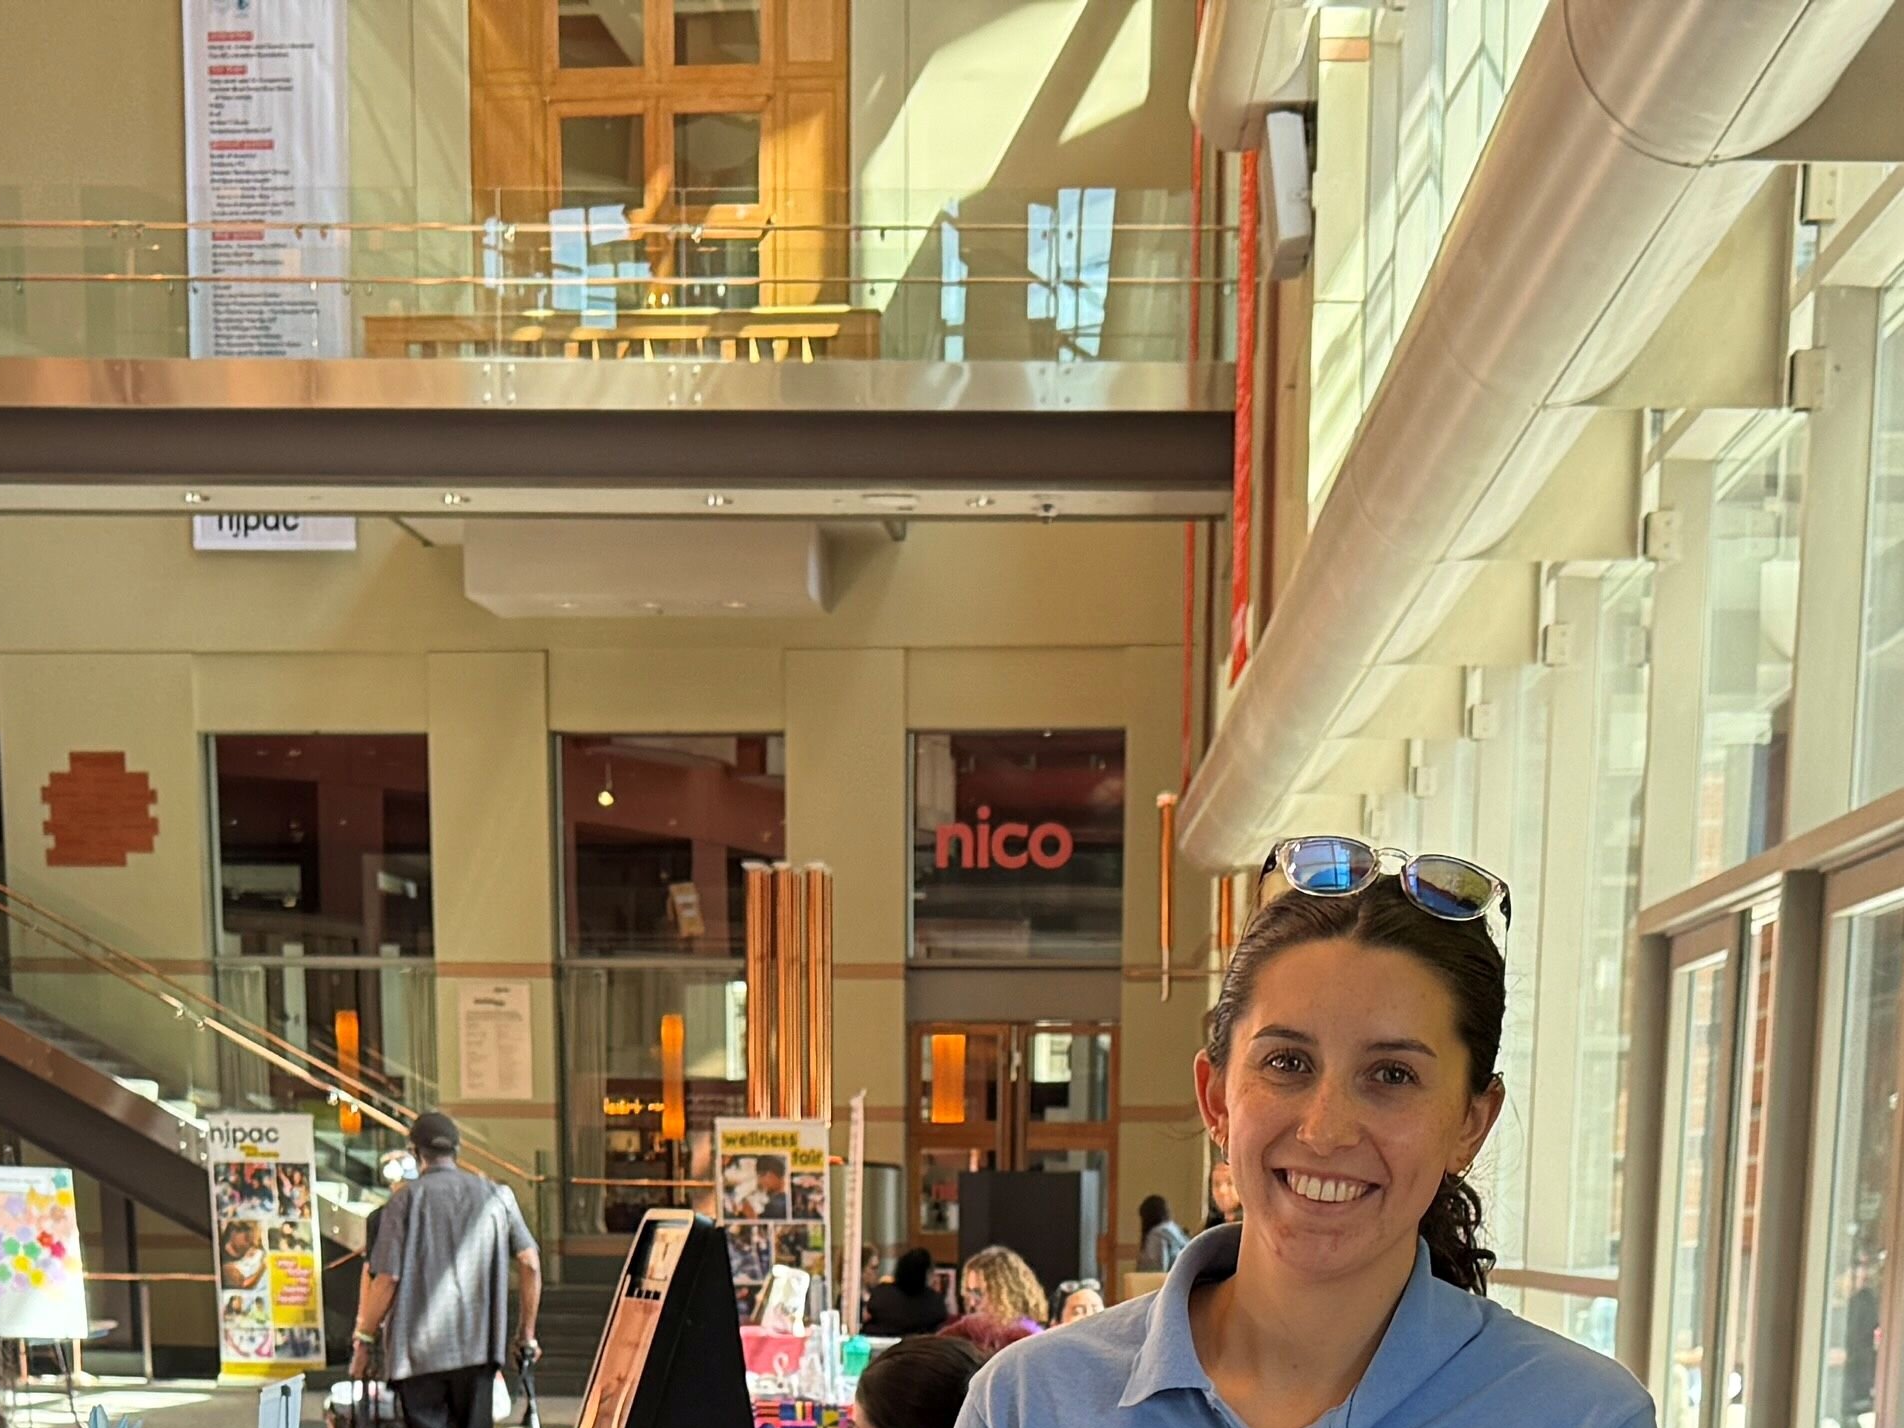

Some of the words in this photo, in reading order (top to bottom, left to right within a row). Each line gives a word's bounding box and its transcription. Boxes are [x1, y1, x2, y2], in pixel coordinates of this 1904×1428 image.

[935, 806, 1073, 869] nico
[210, 1121, 280, 1149] njpac
[723, 1130, 798, 1147] wellness
[790, 1148, 825, 1167] fair
